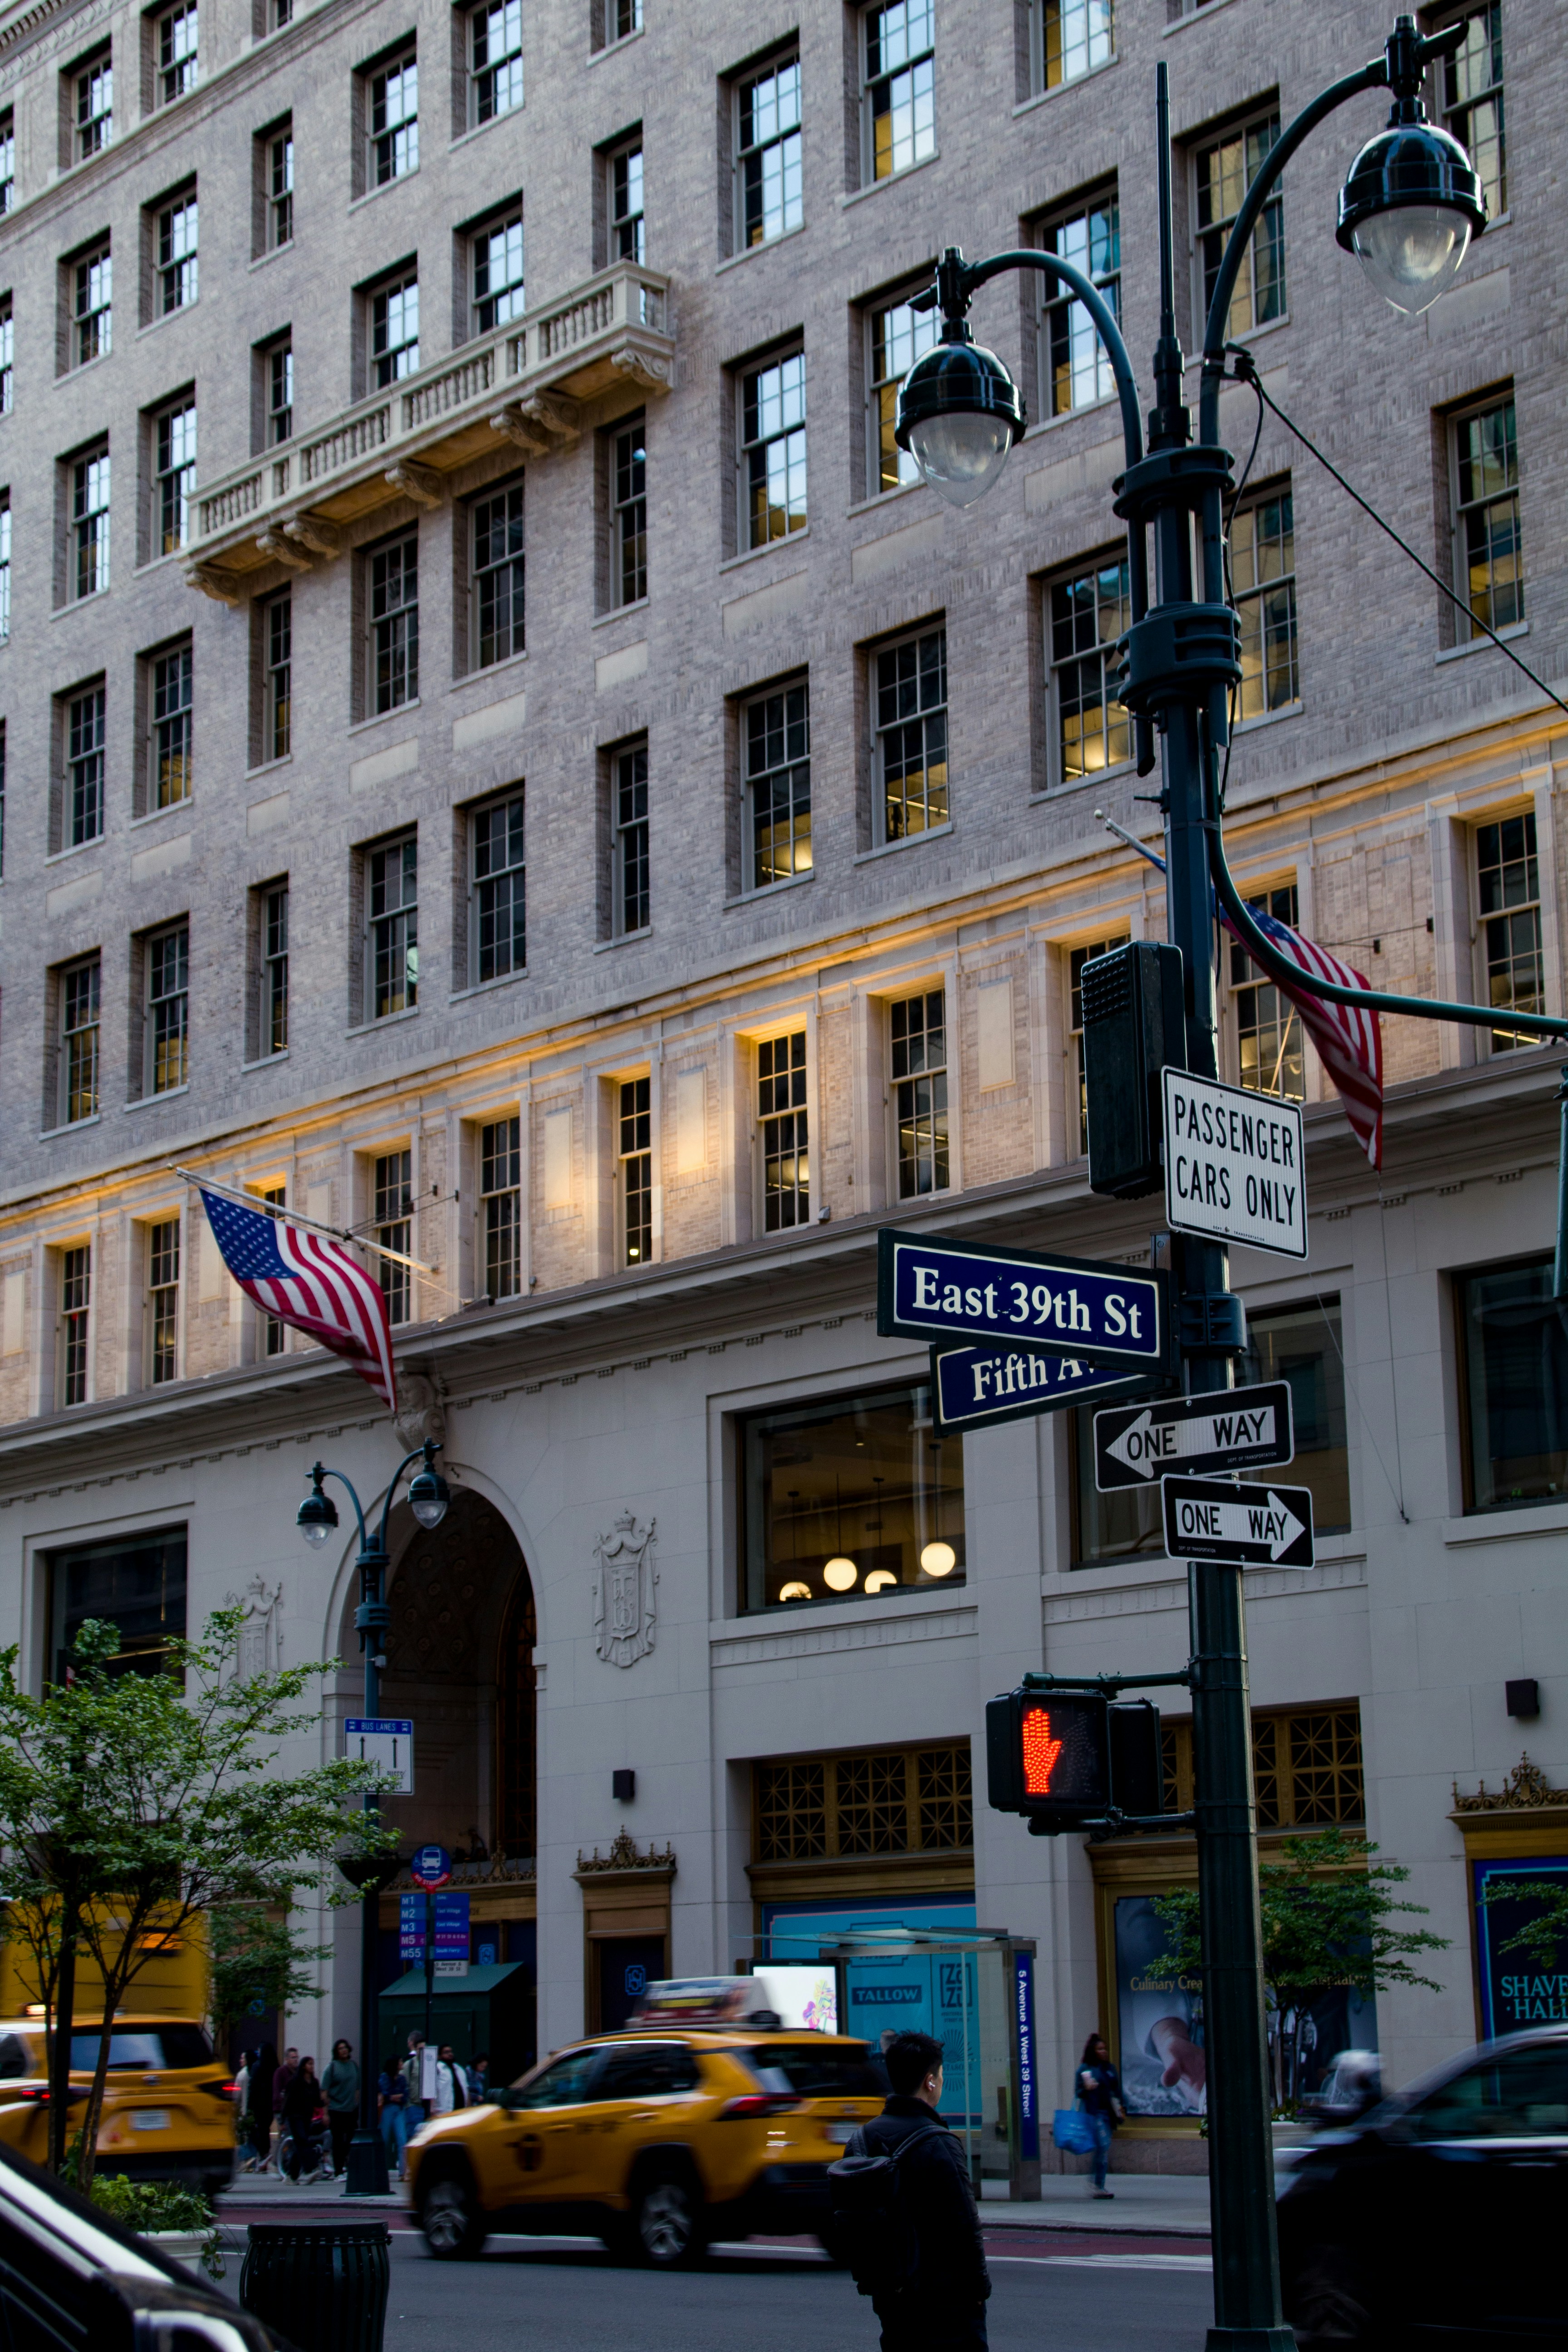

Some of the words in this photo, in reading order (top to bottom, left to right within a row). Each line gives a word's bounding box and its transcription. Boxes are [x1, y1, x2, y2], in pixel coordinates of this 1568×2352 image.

[1174, 1093, 1294, 1168] PASSENGER
[1176, 1155, 1231, 1210] CARS
[1246, 1174, 1295, 1226] ONLY
[1234, 1231, 1265, 1241] TRANSPORTATION
[912, 1266, 999, 1319] East
[1008, 1281, 1092, 1333] 39th
[1104, 1293, 1142, 1338] St
[970, 1353, 1049, 1401] Fifth
[1126, 1425, 1177, 1460] ONE
[1212, 1411, 1267, 1447] WAY
[1245, 1451, 1277, 1460] TRANSPORTATION
[1181, 1502, 1223, 1536] ONE
[1248, 1508, 1289, 1541] WAY
[361, 1722, 374, 1730] BUS
[376, 1723, 396, 1731] LANES
[414, 1874, 422, 1882] NO
[422, 1873, 448, 1886] STANDING
[401, 1896, 414, 1905] M1
[401, 1909, 415, 1918] M2
[401, 1922, 415, 1932] M3
[401, 1934, 416, 1945] M5
[401, 1948, 421, 1958] M55
[1018, 1970, 1027, 1978] 5
[1130, 1976, 1176, 1993] Culinary
[856, 1988, 919, 2002] TALLOW
[1019, 1980, 1027, 2023] Avenue
[1020, 2024, 1029, 2034] &
[1020, 2036, 1030, 2065] West
[1022, 2068, 1030, 2082] 39
[1022, 2083, 1031, 2118] Street
